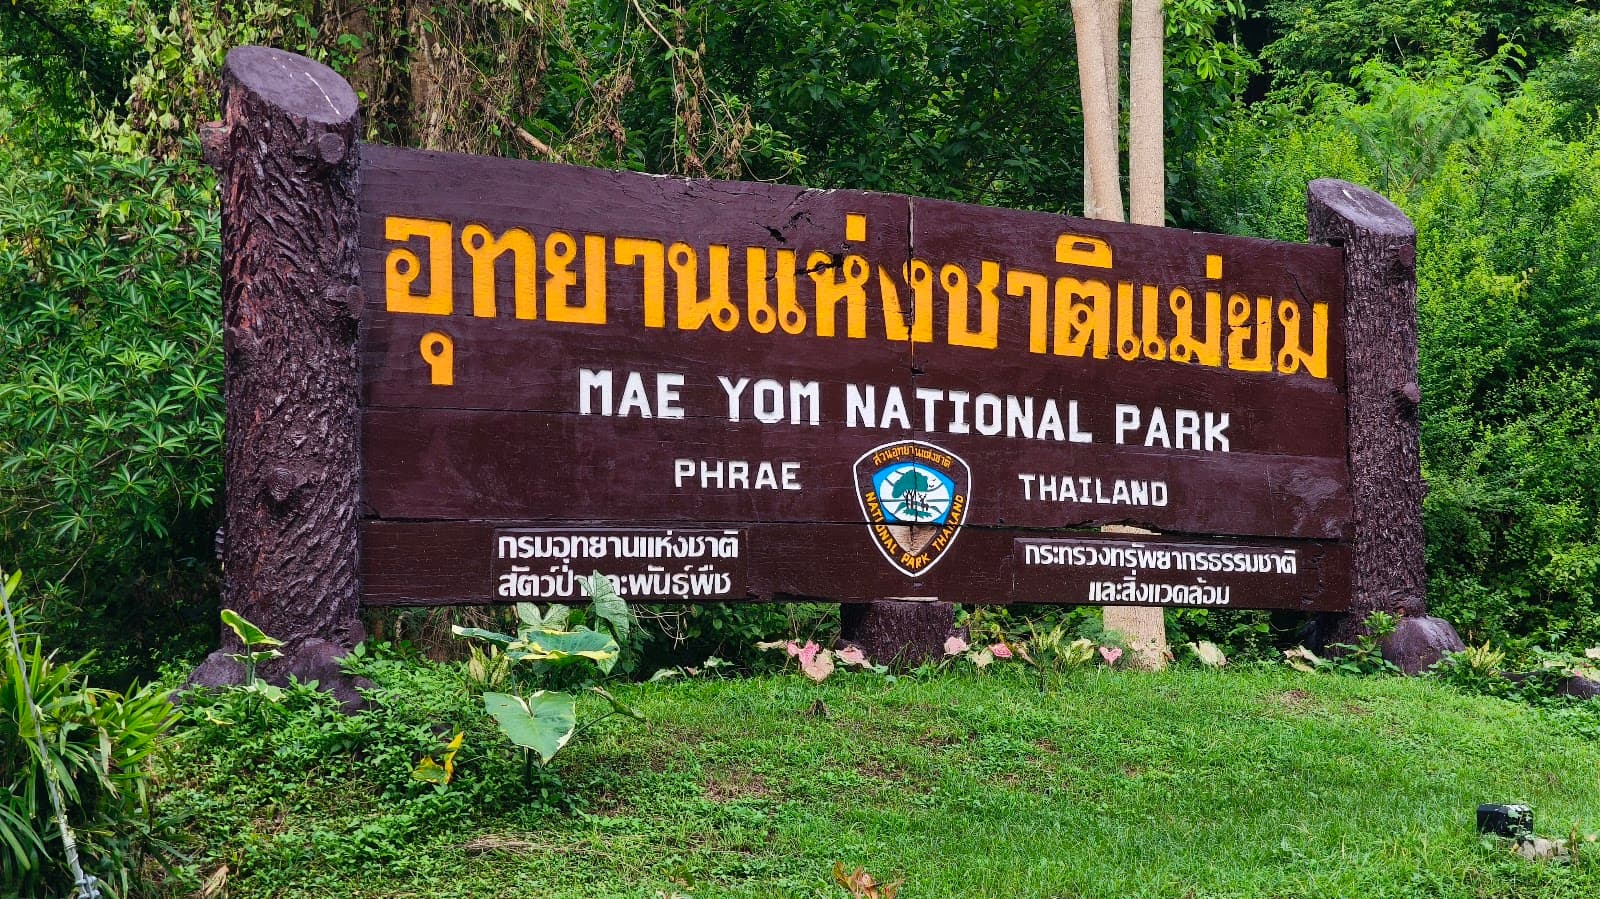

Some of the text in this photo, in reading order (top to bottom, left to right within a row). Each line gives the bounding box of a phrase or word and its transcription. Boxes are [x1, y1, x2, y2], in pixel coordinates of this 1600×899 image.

[384, 213, 1329, 386] อุทยานแห่งชาติแม่ยม
[578, 367, 1231, 453] MAE YOM NATIONAL PARK
[674, 458, 802, 490] PHRAE
[1018, 473, 1168, 507] THAILAND
[498, 530, 739, 564] กรมอุทยานแห่งชาติ
[865, 491, 965, 569] NATIONAL PARK THAILAND
[1024, 543, 1297, 575] กระทรวงทรัพยากรธรรมชาติ
[1088, 569, 1231, 606] และสิ่งแวดล้อม
